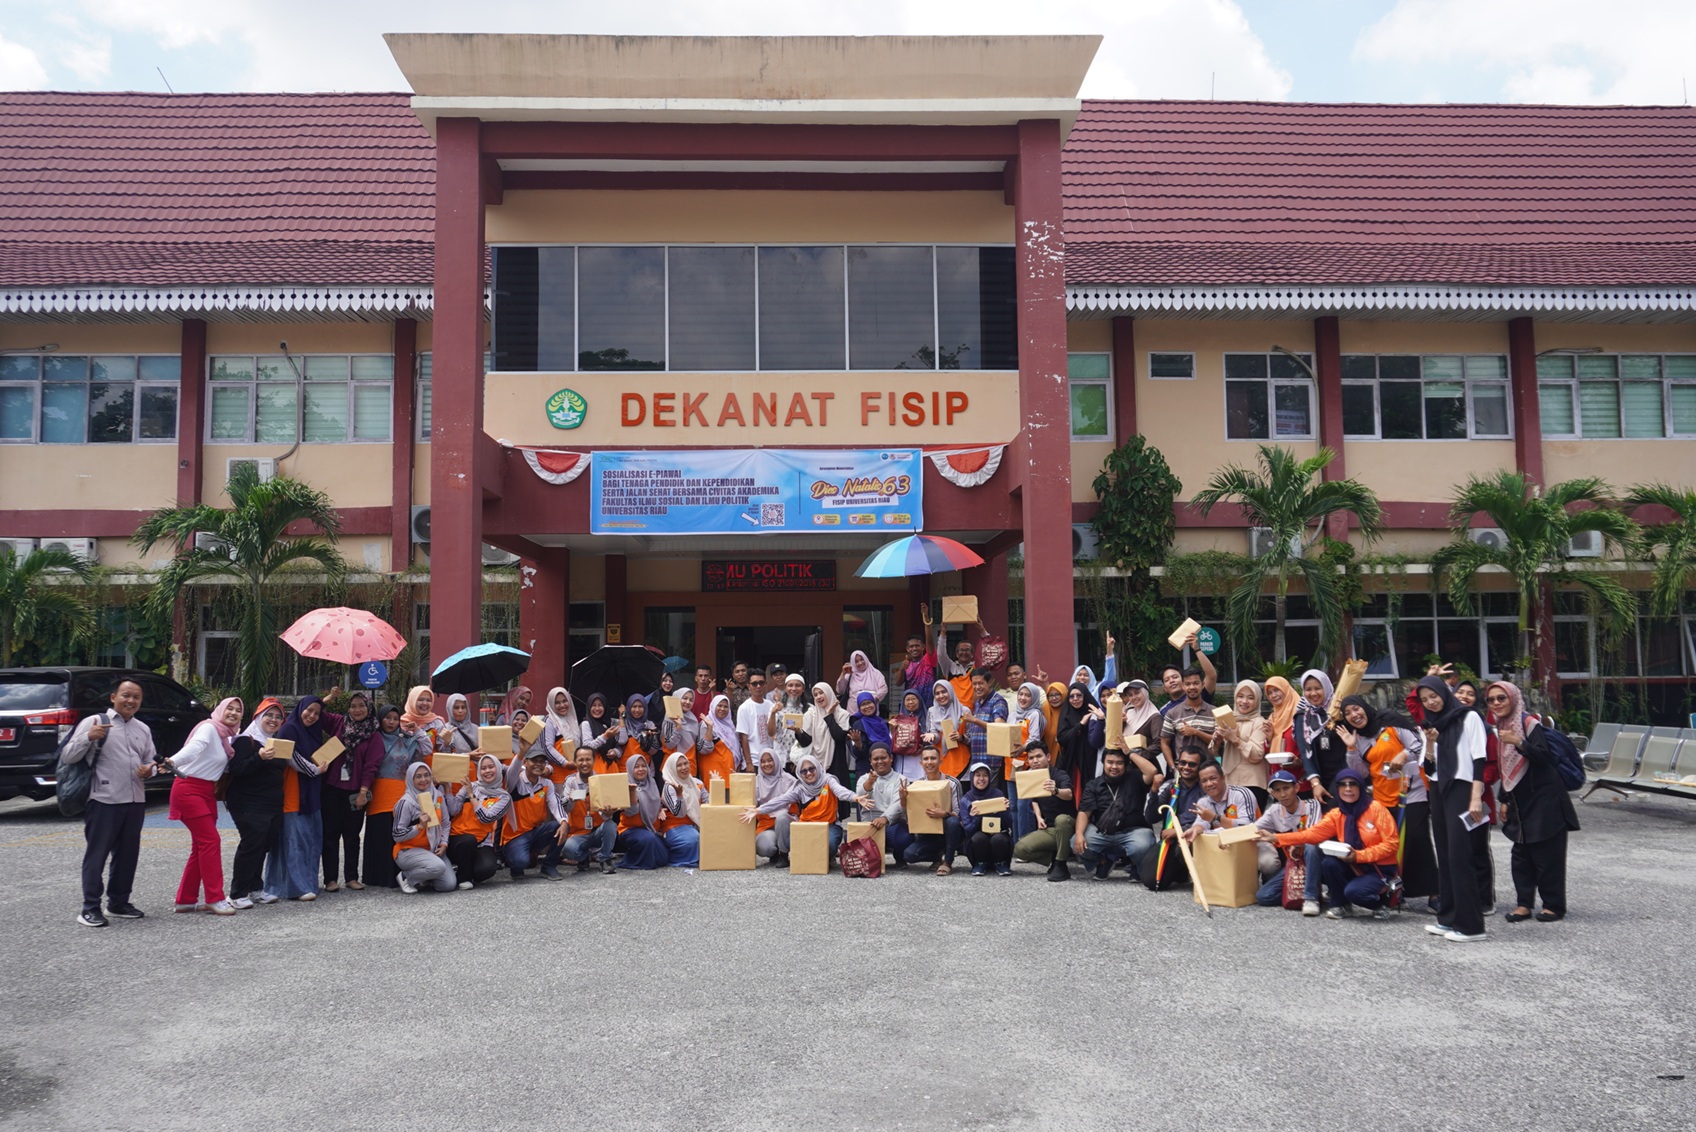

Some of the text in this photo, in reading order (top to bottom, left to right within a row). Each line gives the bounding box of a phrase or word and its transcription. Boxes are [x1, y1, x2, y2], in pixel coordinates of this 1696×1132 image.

[620, 391, 969, 427] DEKANAT FISIP
[602, 469, 682, 479] SOSIALISASI E-PIAWAI
[602, 477, 755, 488] BAGI TENAGA PENDIDIK DAN KEPENDIDIKAN
[811, 475, 911, 499] Dies Natalis 63
[602, 486, 780, 498] SERTA JALAN SEHAT BERSAMA CIVITAS AKADEMIKA
[602, 496, 750, 507] FAKULTAS ILMU SOSIAL DAN ILMU POLITIK
[846, 497, 878, 506] UNIVERSITAS
[601, 506, 668, 516] UNIVERSITAS RIAU
[751, 563, 813, 578] POLITIK
